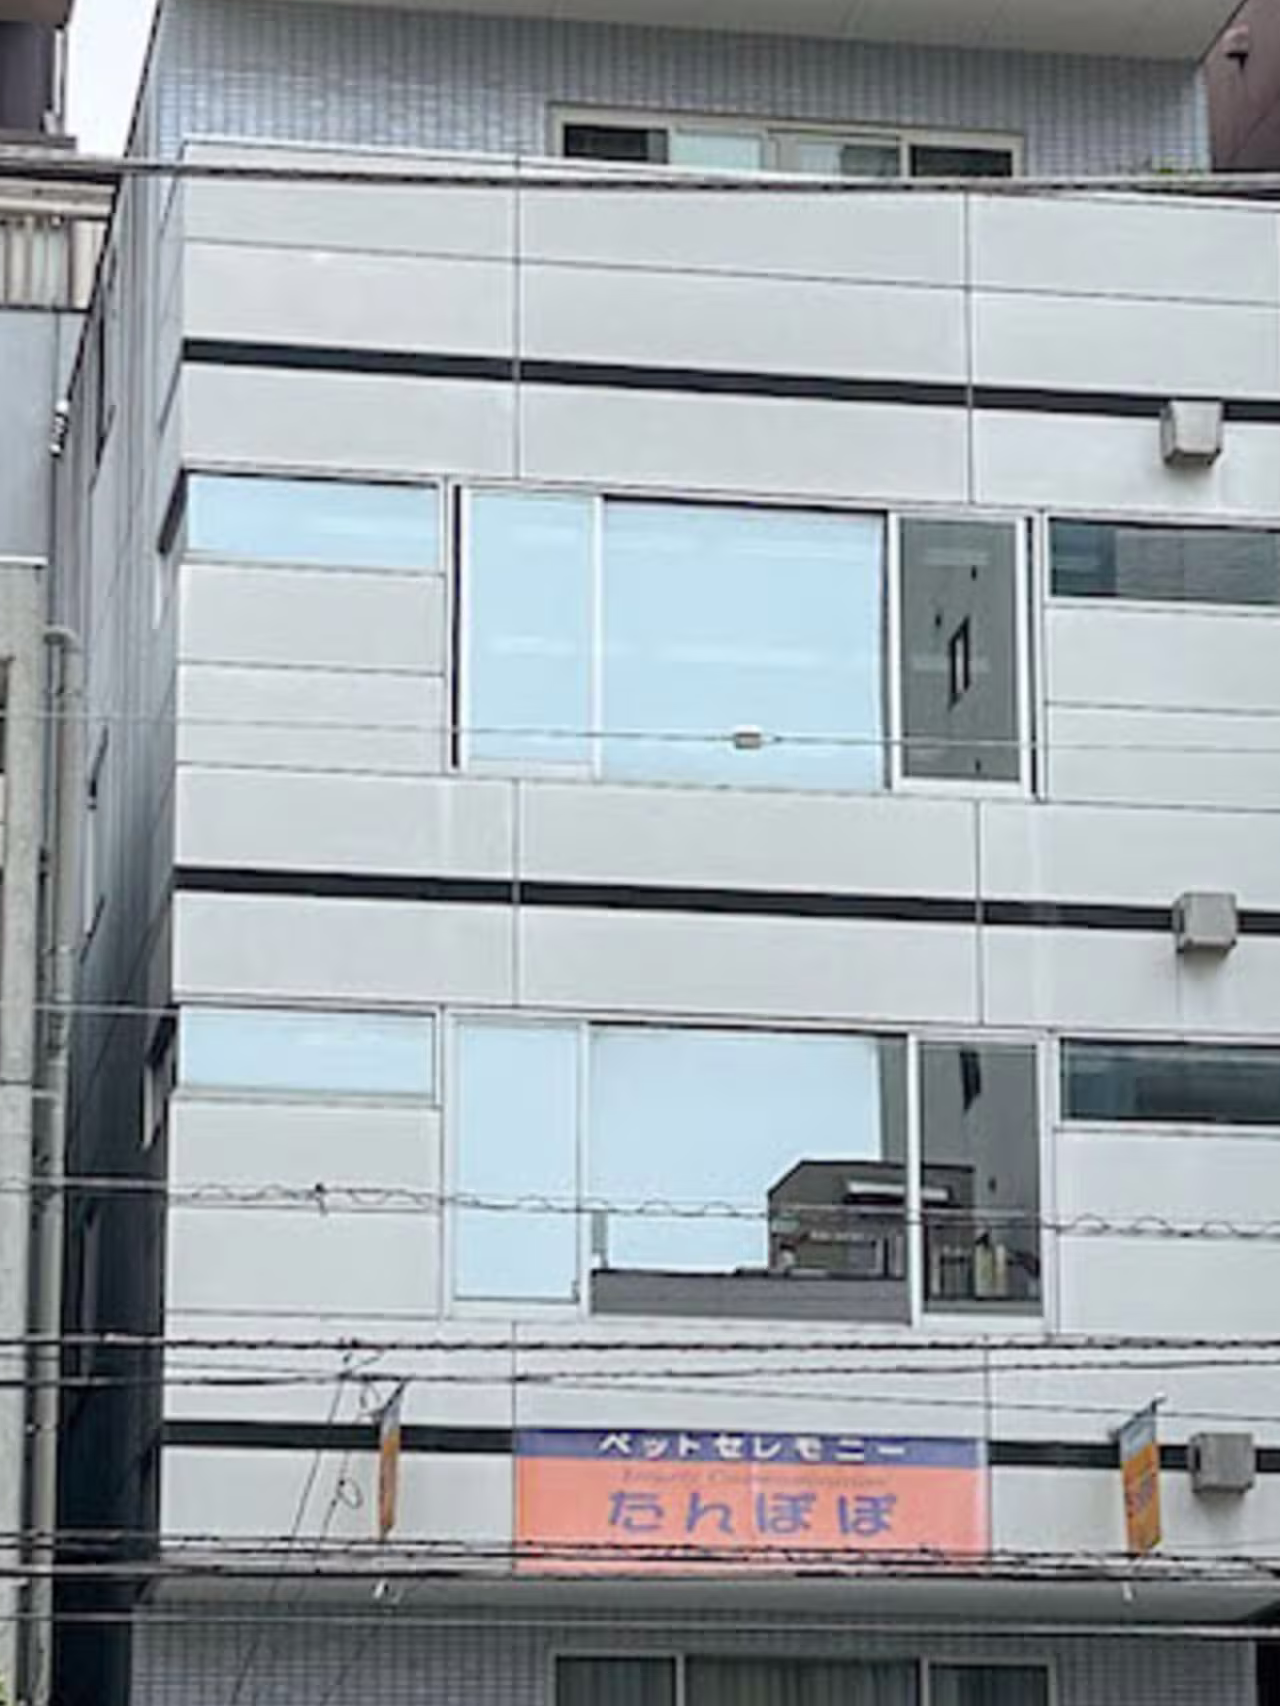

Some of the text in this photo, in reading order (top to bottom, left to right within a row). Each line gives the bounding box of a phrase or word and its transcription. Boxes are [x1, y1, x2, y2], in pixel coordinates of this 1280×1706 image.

[598, 1432, 907, 1461] ペットセレモニー
[607, 1489, 898, 1537] たんぽぽ
